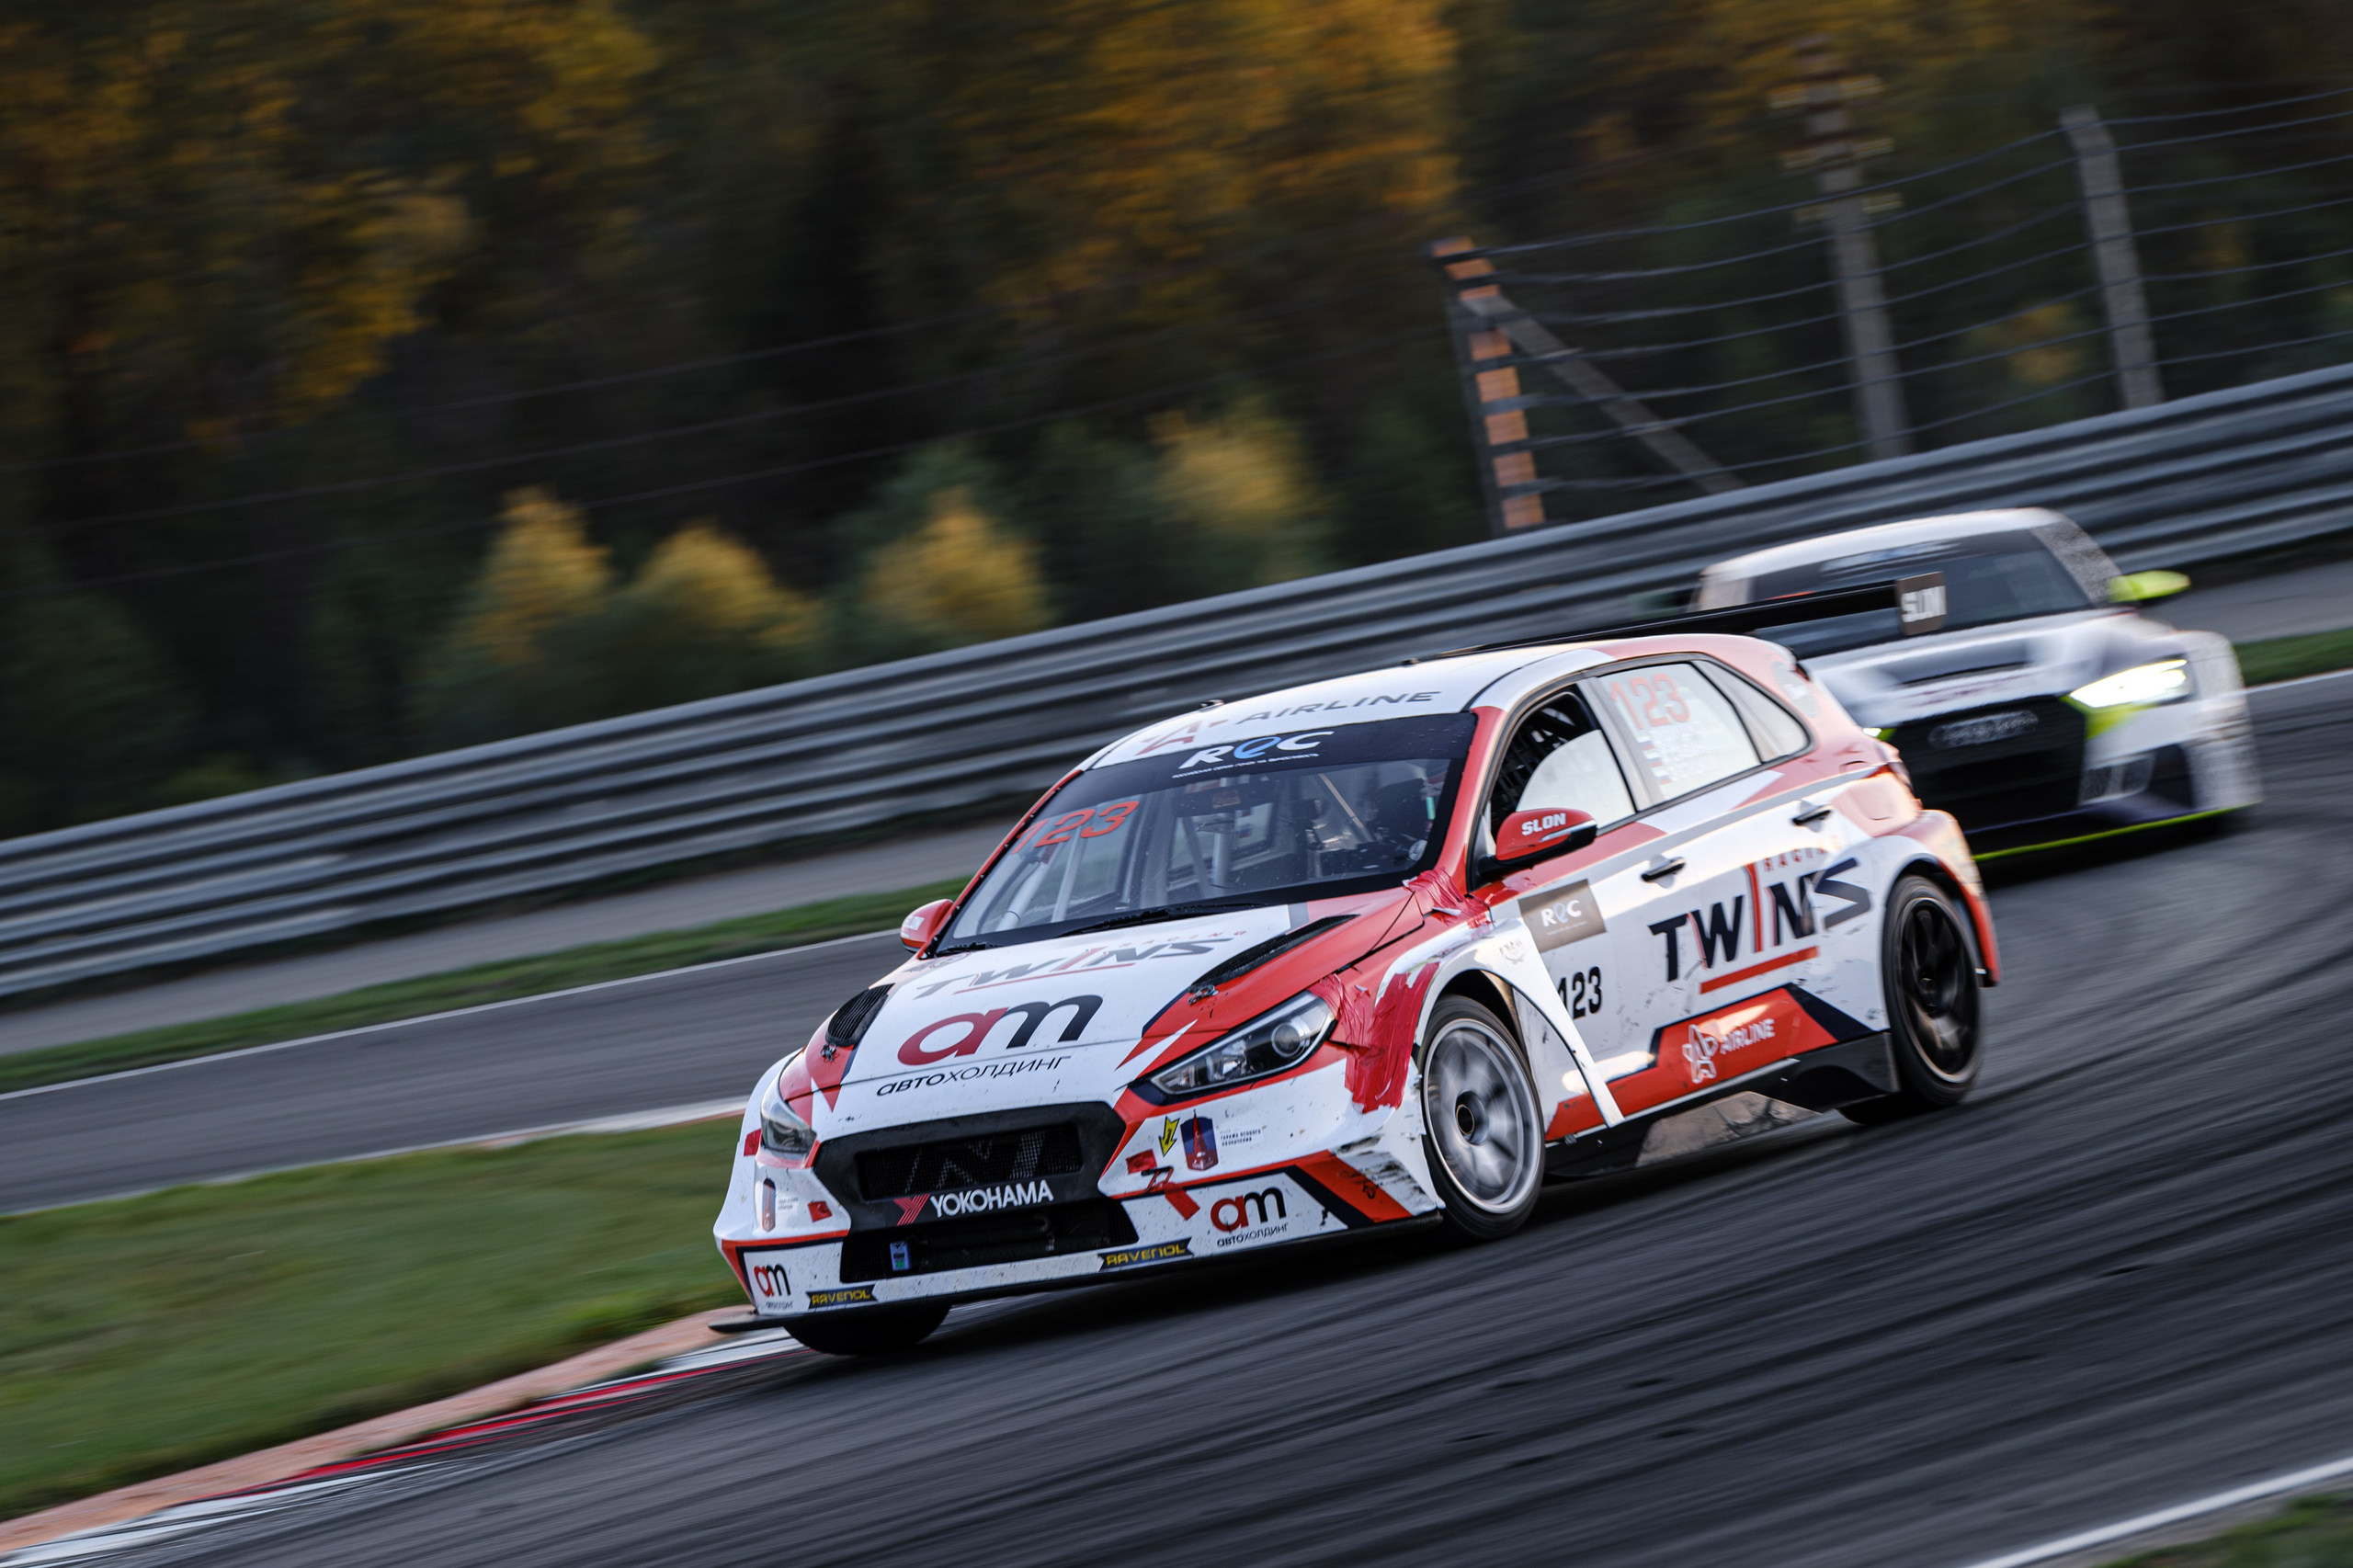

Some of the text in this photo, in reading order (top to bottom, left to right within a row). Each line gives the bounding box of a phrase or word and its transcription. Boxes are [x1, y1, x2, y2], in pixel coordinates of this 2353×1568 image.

[1234, 691, 1441, 726] AIRLINE
[1609, 672, 1692, 731] 123
[1011, 800, 1141, 855] 123
[1521, 812, 1567, 836] SLON
[1648, 857, 1871, 982] TWINS
[913, 937, 1234, 1001] TWINS
[1558, 966, 1602, 1020] 123
[1719, 1017, 1776, 1056] AIRLINE
[930, 1178, 1055, 1219] YOKOHAMA
[1106, 1243, 1187, 1267] RAVENOL
[811, 1289, 871, 1306] RAVENOL
